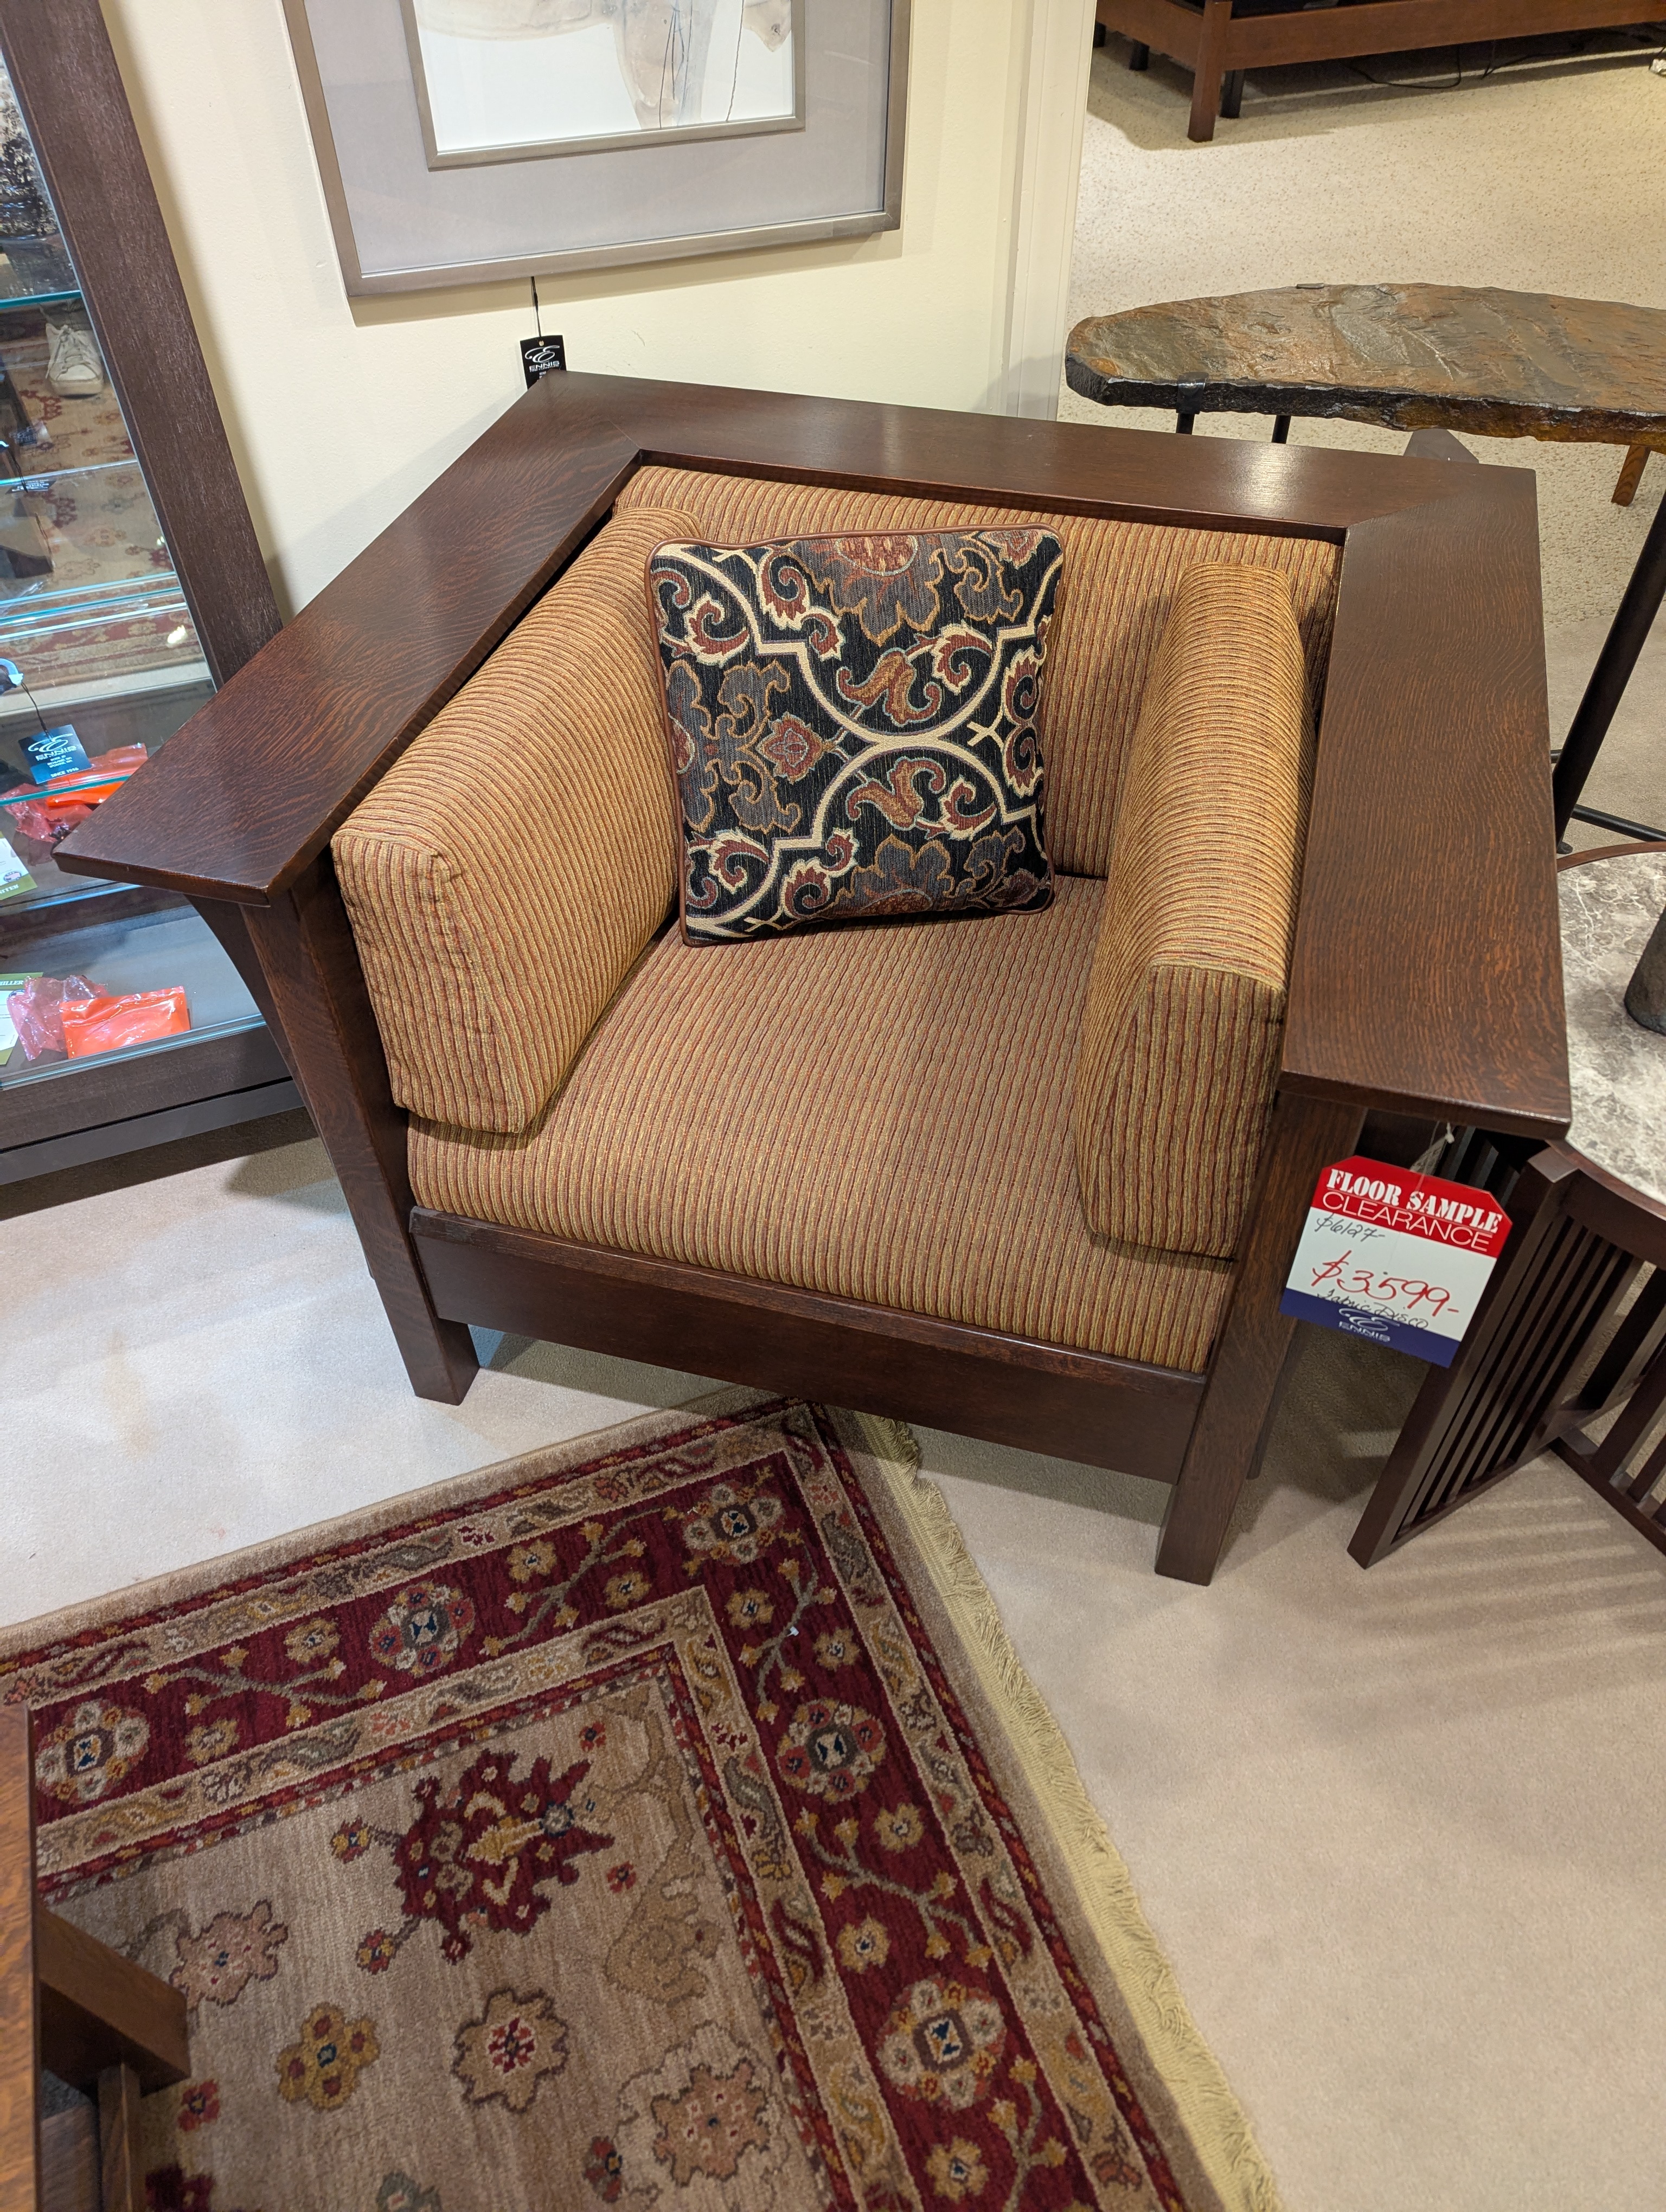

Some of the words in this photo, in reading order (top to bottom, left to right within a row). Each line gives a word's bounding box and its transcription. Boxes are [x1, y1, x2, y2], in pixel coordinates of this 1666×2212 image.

[529, 361, 560, 370] ENNIS
[35, 745, 76, 760] ENNIS
[1327, 1169, 1402, 1206] FLOOR
[1406, 1190, 1503, 1233] SAMPLE
[1322, 1192, 1493, 1252] CLEARANCE
[1338, 1321, 1391, 1342] ENNIS
